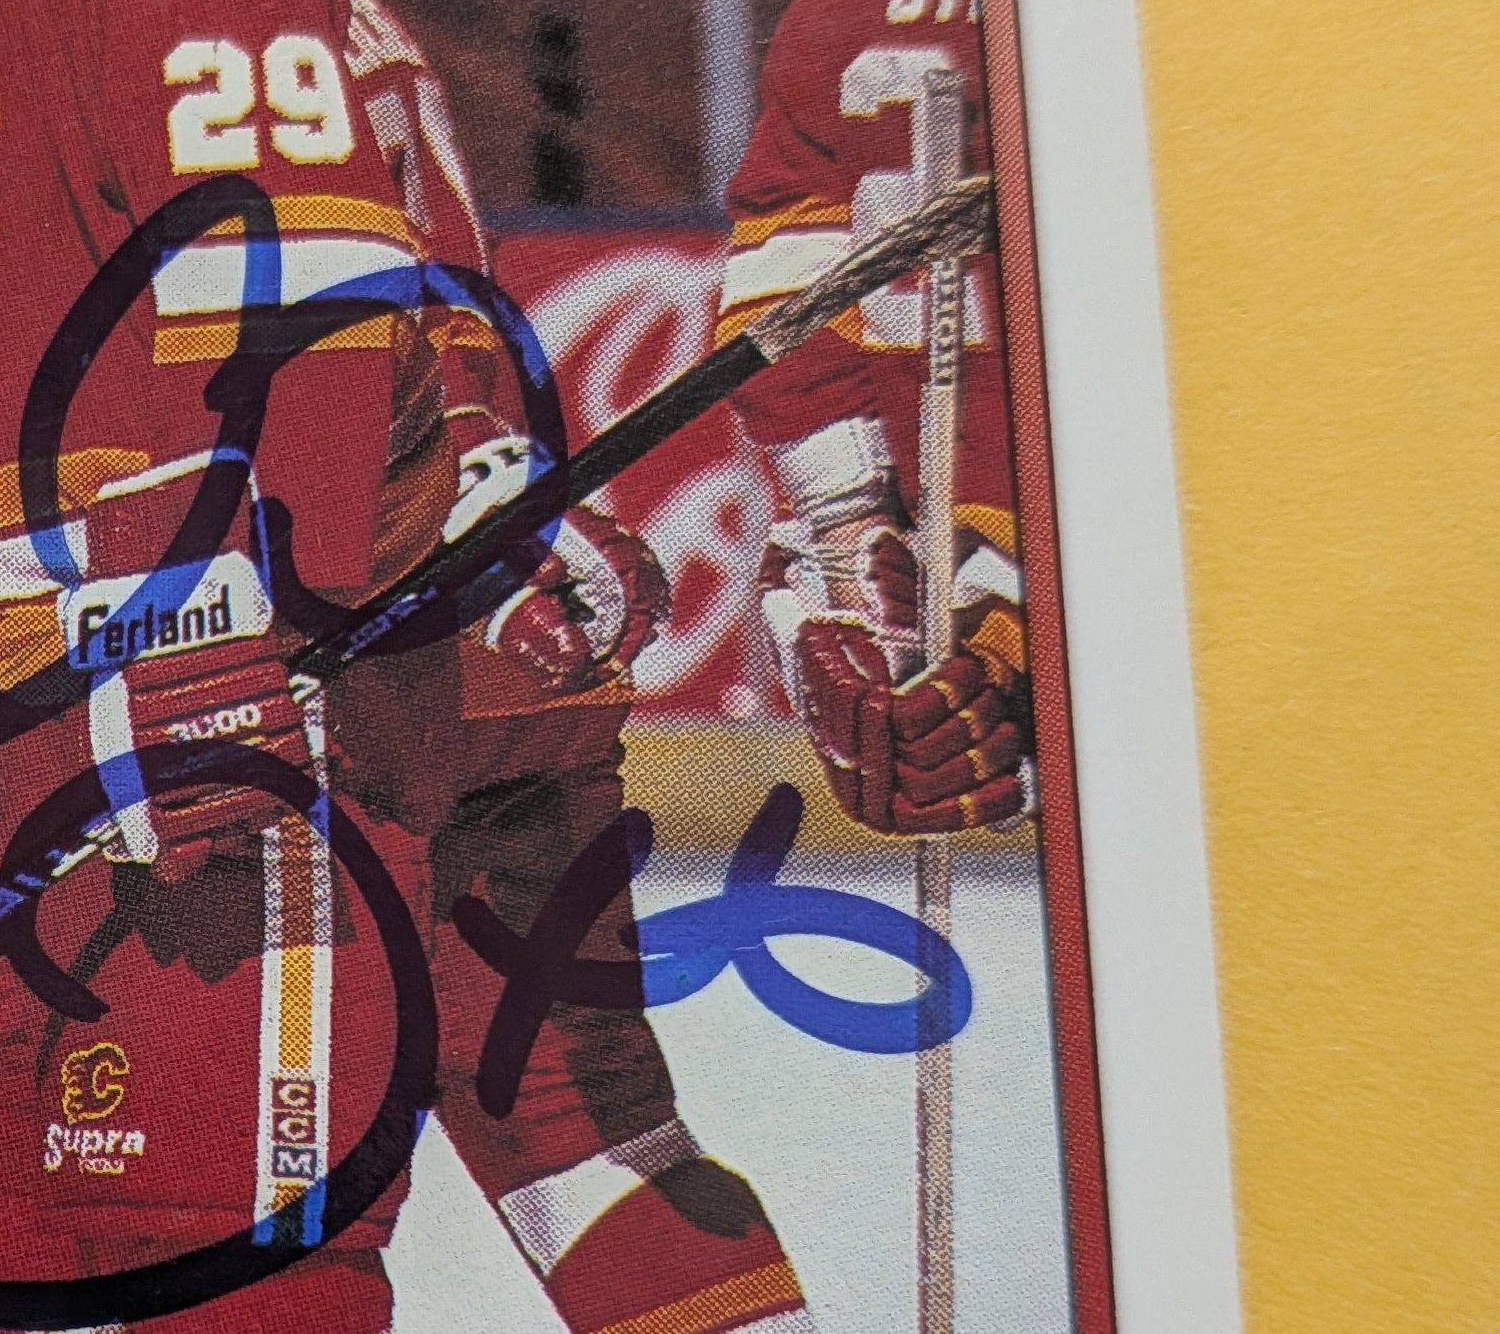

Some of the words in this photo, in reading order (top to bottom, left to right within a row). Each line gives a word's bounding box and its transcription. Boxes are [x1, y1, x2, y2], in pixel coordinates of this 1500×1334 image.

[163, 33, 357, 175] 29
[78, 583, 231, 663] Ferland
[42, 1122, 147, 1173] Supra
